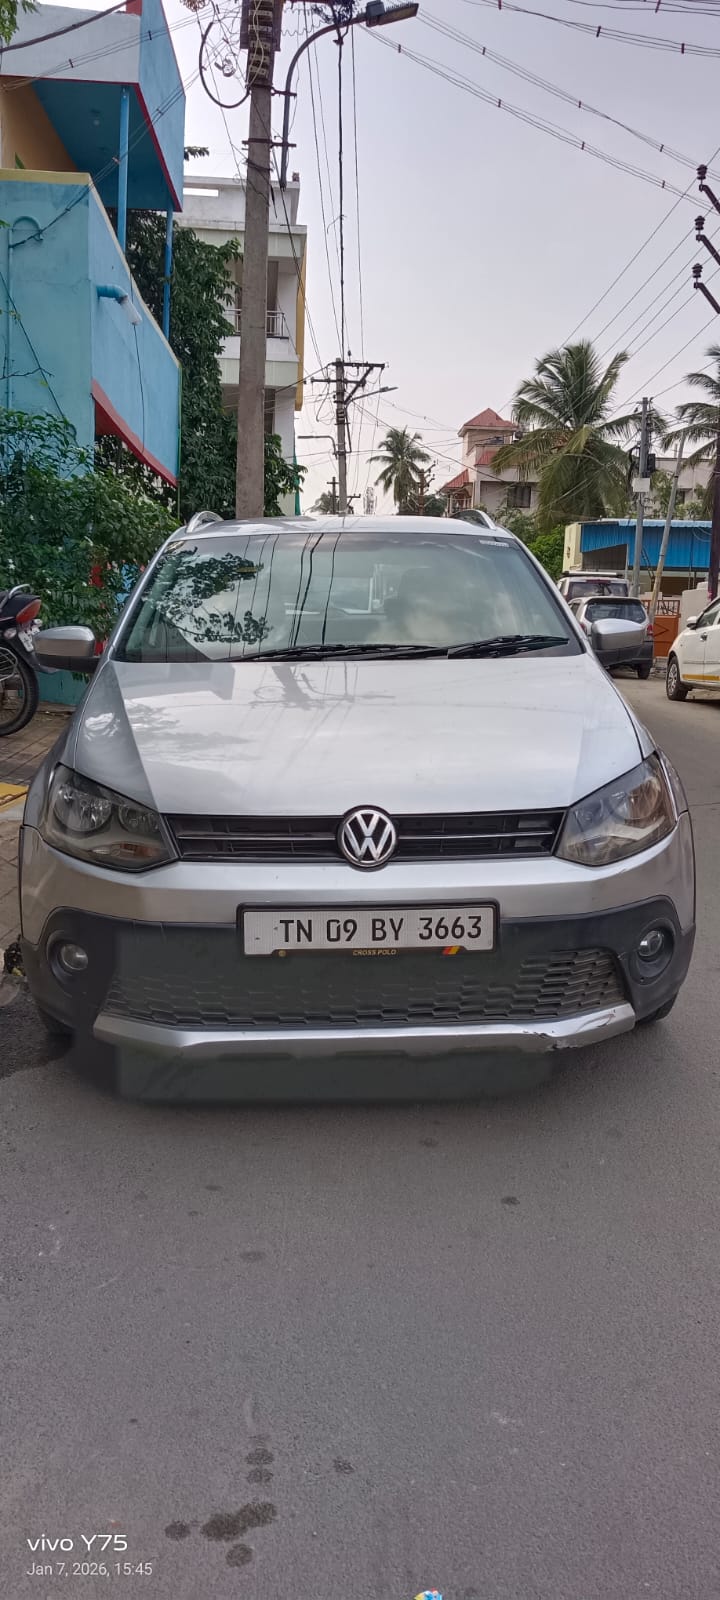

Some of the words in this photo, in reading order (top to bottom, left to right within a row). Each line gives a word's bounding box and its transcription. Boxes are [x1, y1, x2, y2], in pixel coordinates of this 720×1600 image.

[279, 919, 313, 943] TN
[326, 919, 358, 942] 09
[371, 917, 404, 941] BY
[418, 915, 482, 940] 3663
